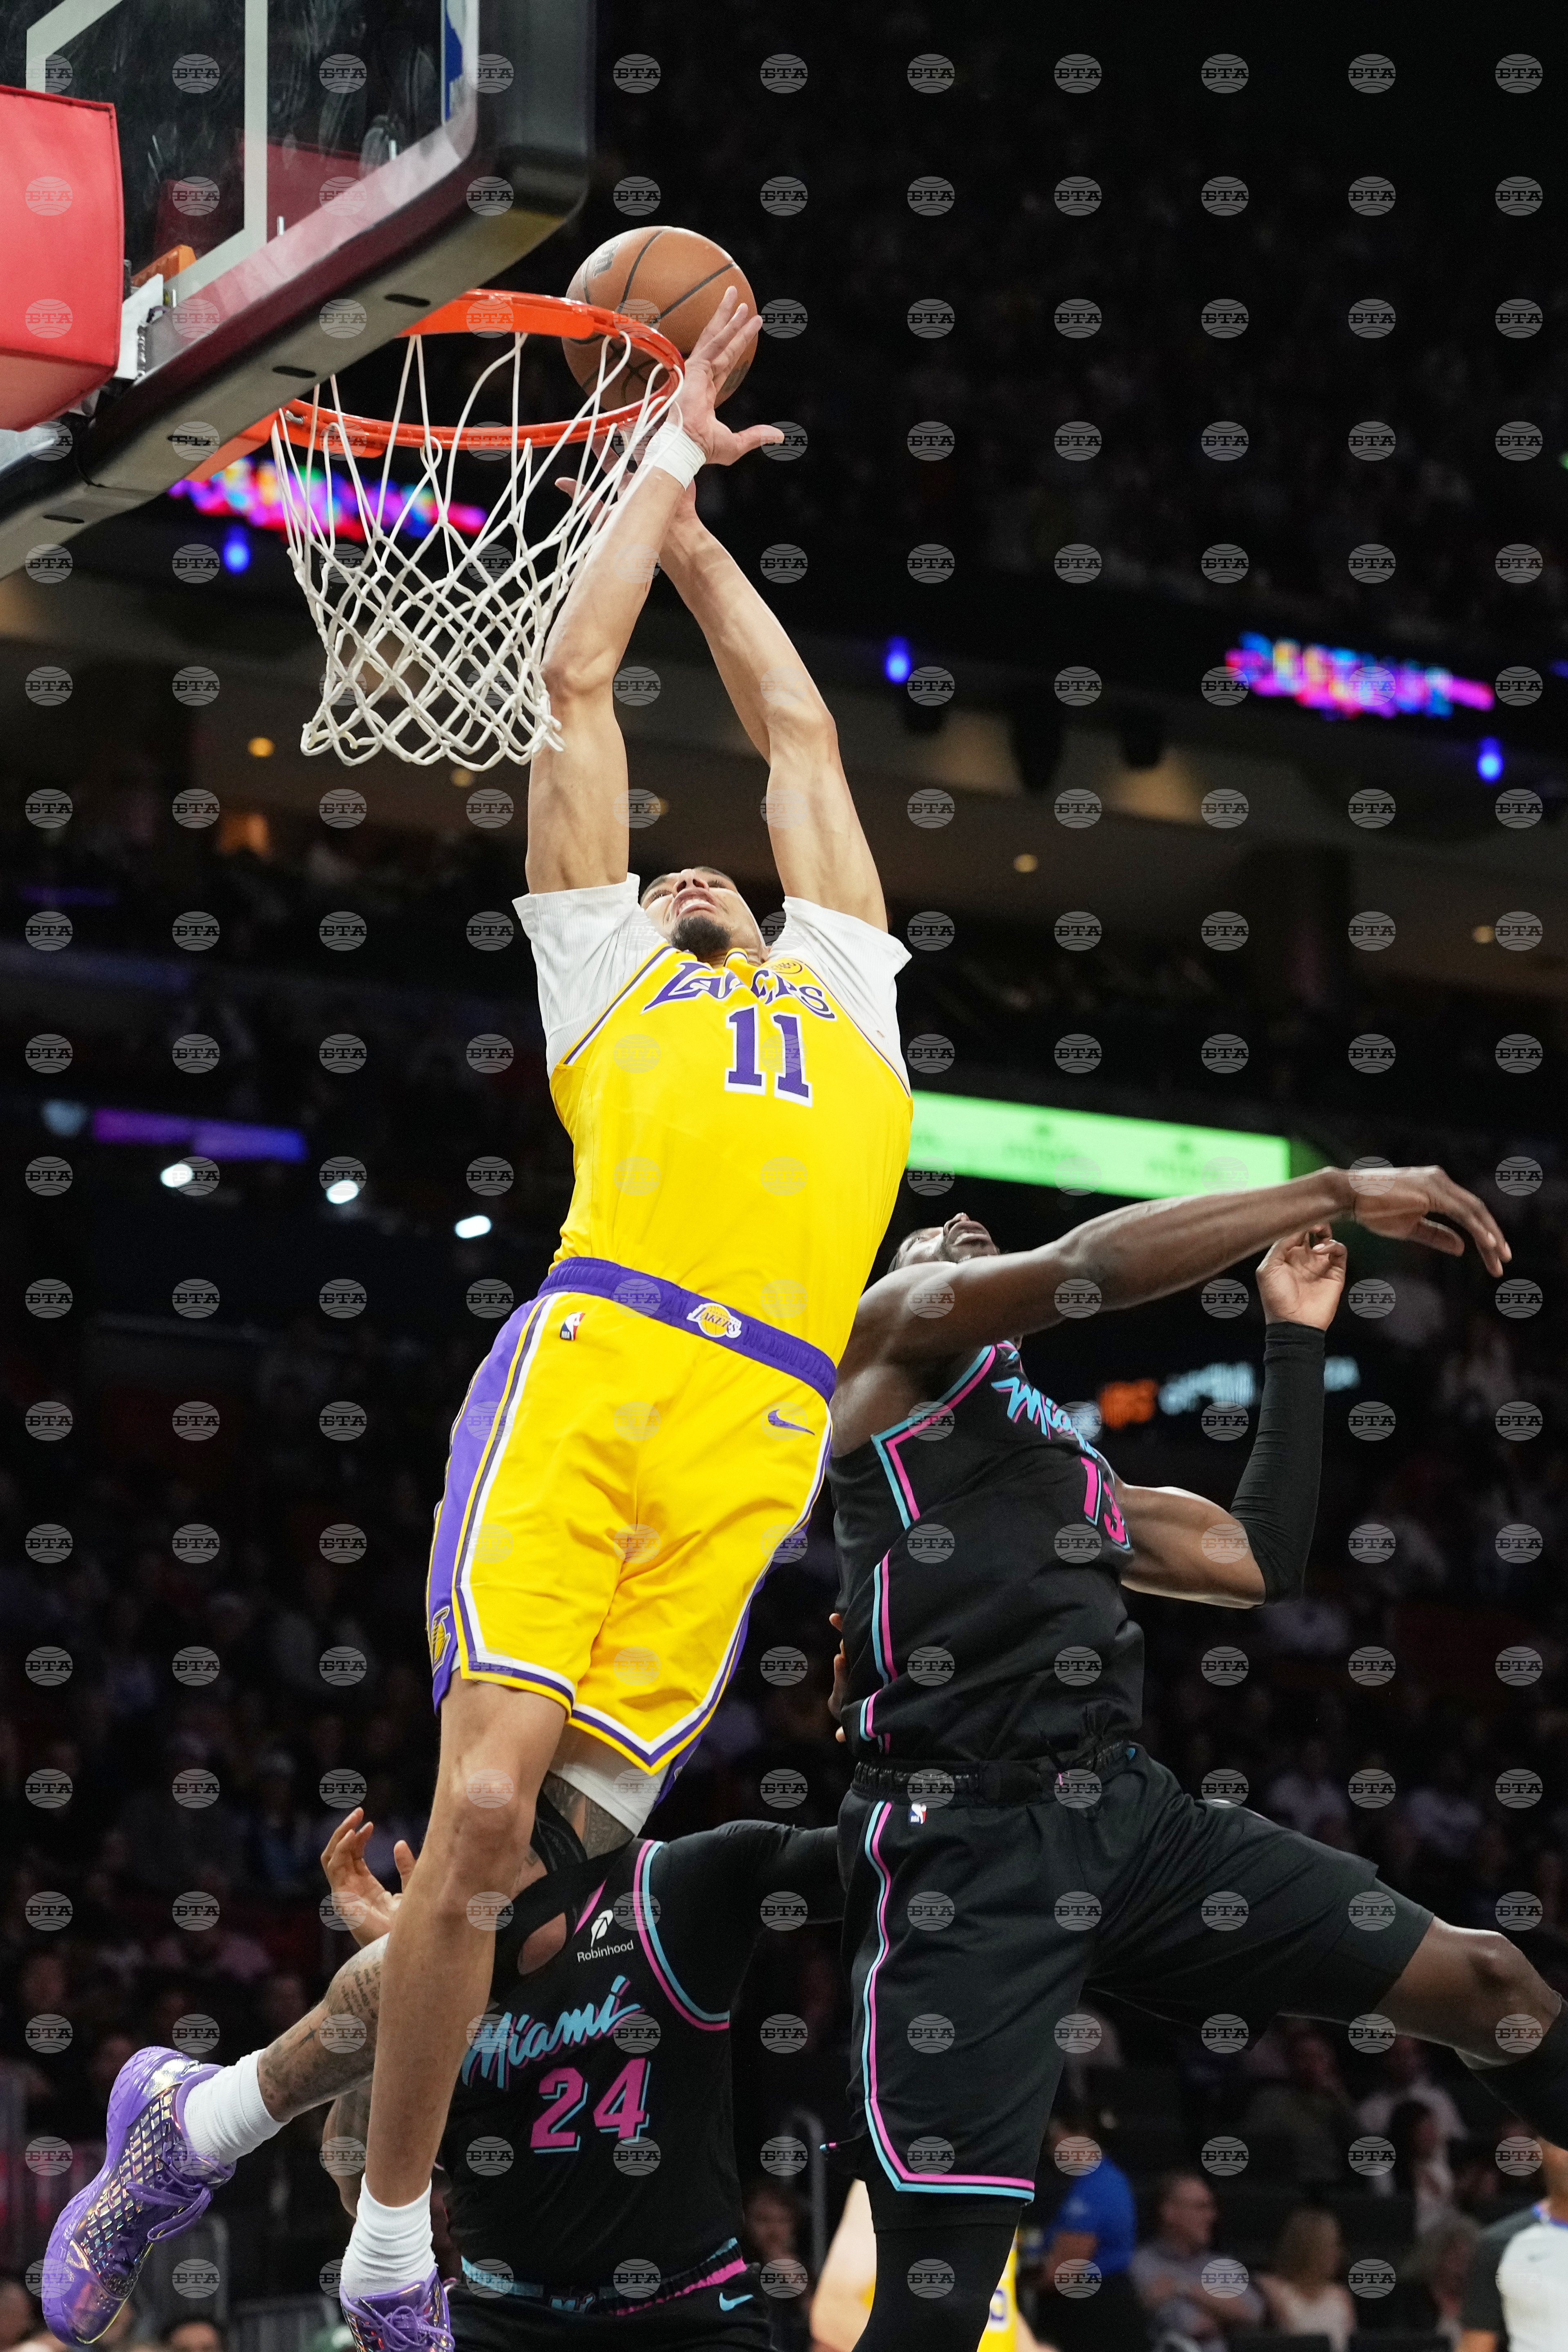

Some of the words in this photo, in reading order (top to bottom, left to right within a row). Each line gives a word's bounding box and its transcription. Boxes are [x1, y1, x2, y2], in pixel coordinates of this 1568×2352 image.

[724, 1003, 813, 1108] 11
[577, 1939, 634, 1963] Robinhood
[462, 1975, 645, 2090] Miami
[530, 2058, 650, 2154] 24
